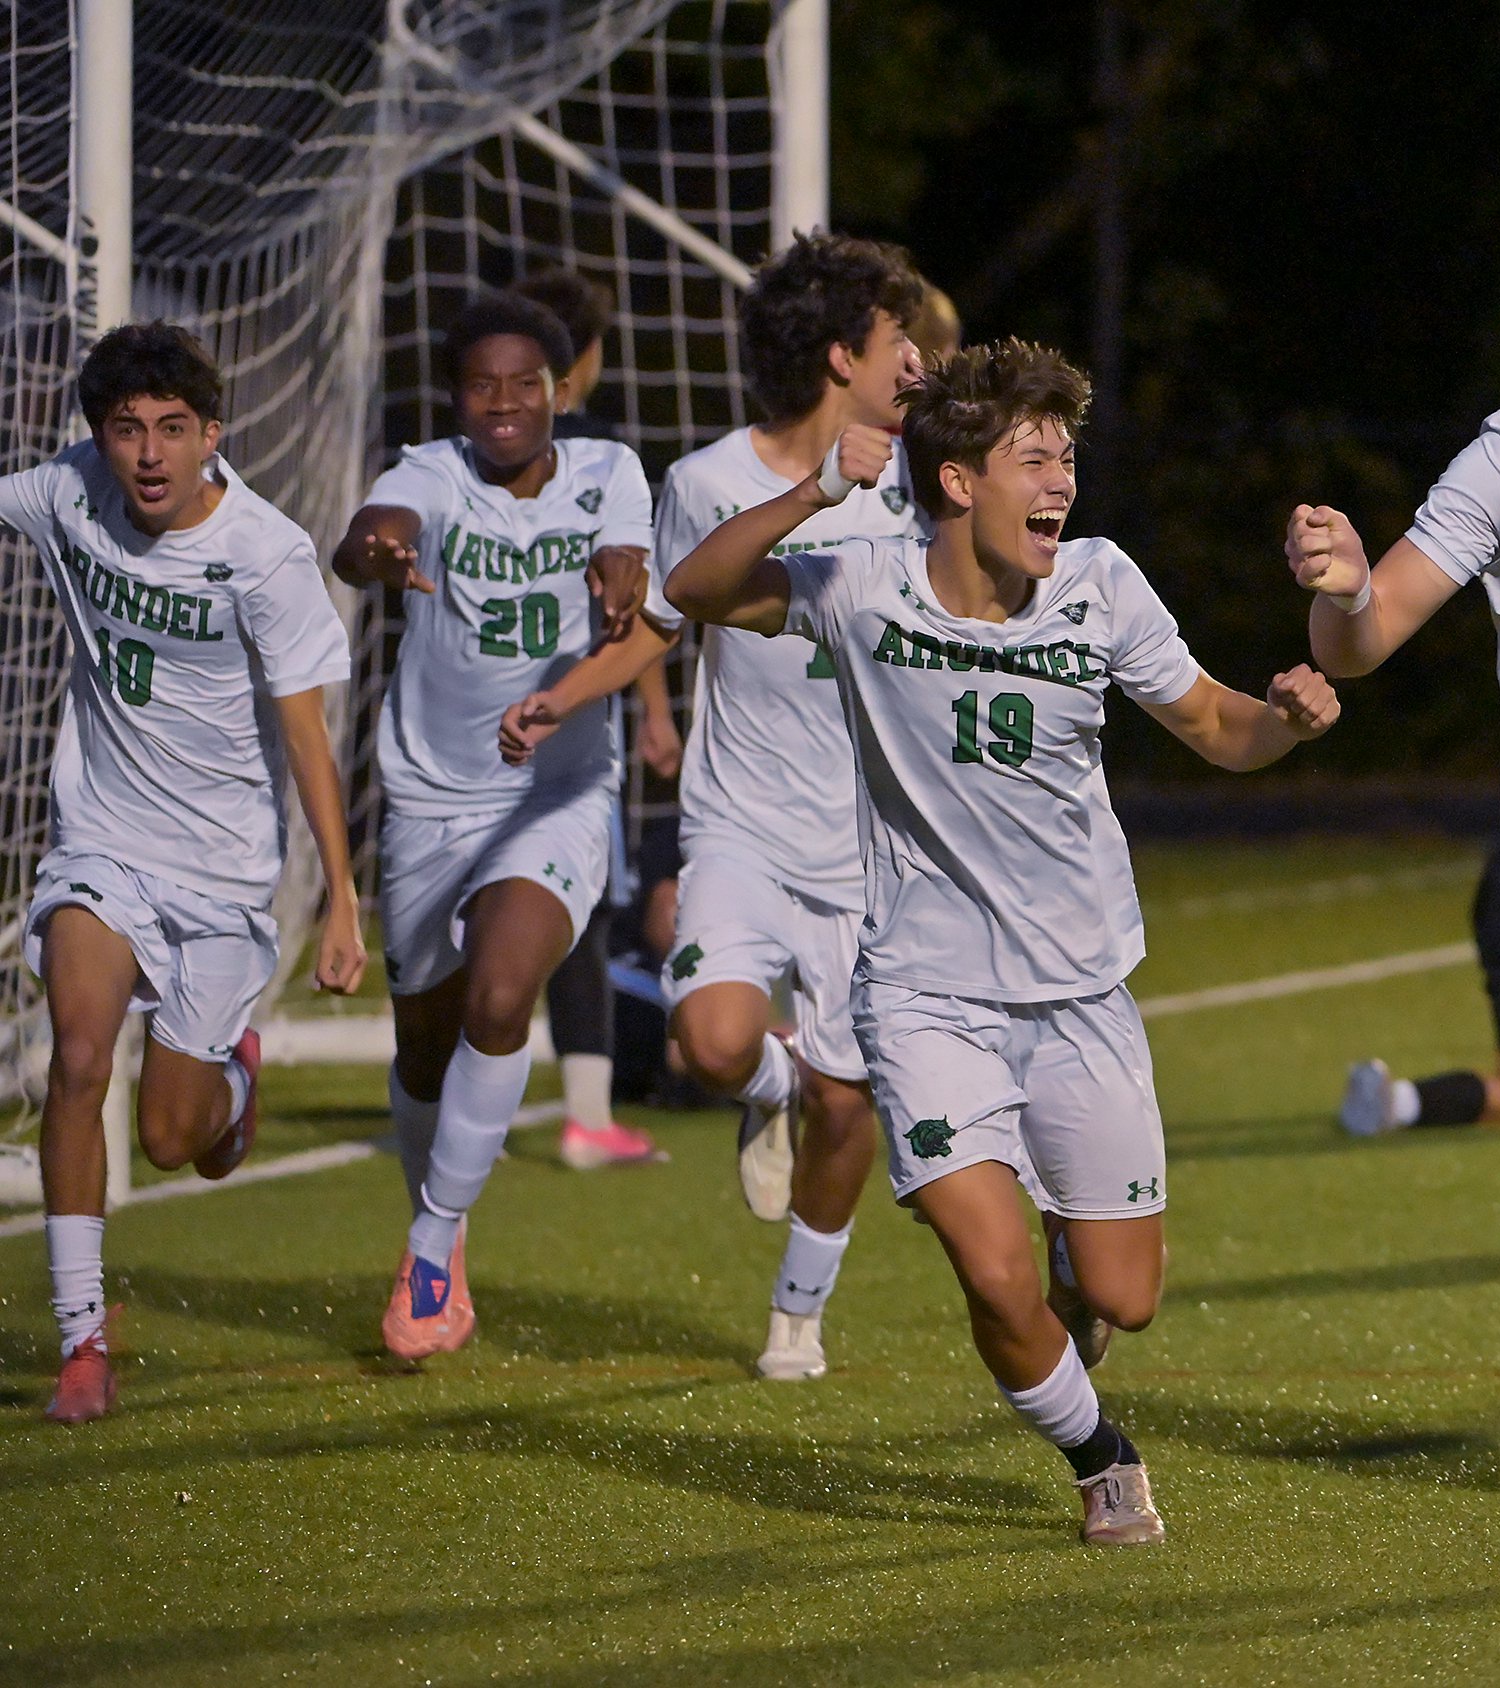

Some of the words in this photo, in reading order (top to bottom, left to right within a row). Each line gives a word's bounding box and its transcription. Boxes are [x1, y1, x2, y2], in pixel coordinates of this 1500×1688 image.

[441, 523, 593, 584] RUNDE
[479, 591, 560, 659] 20
[873, 620, 1109, 685] ARUNDEL
[94, 627, 155, 707] 10
[952, 690, 1034, 767] 19
